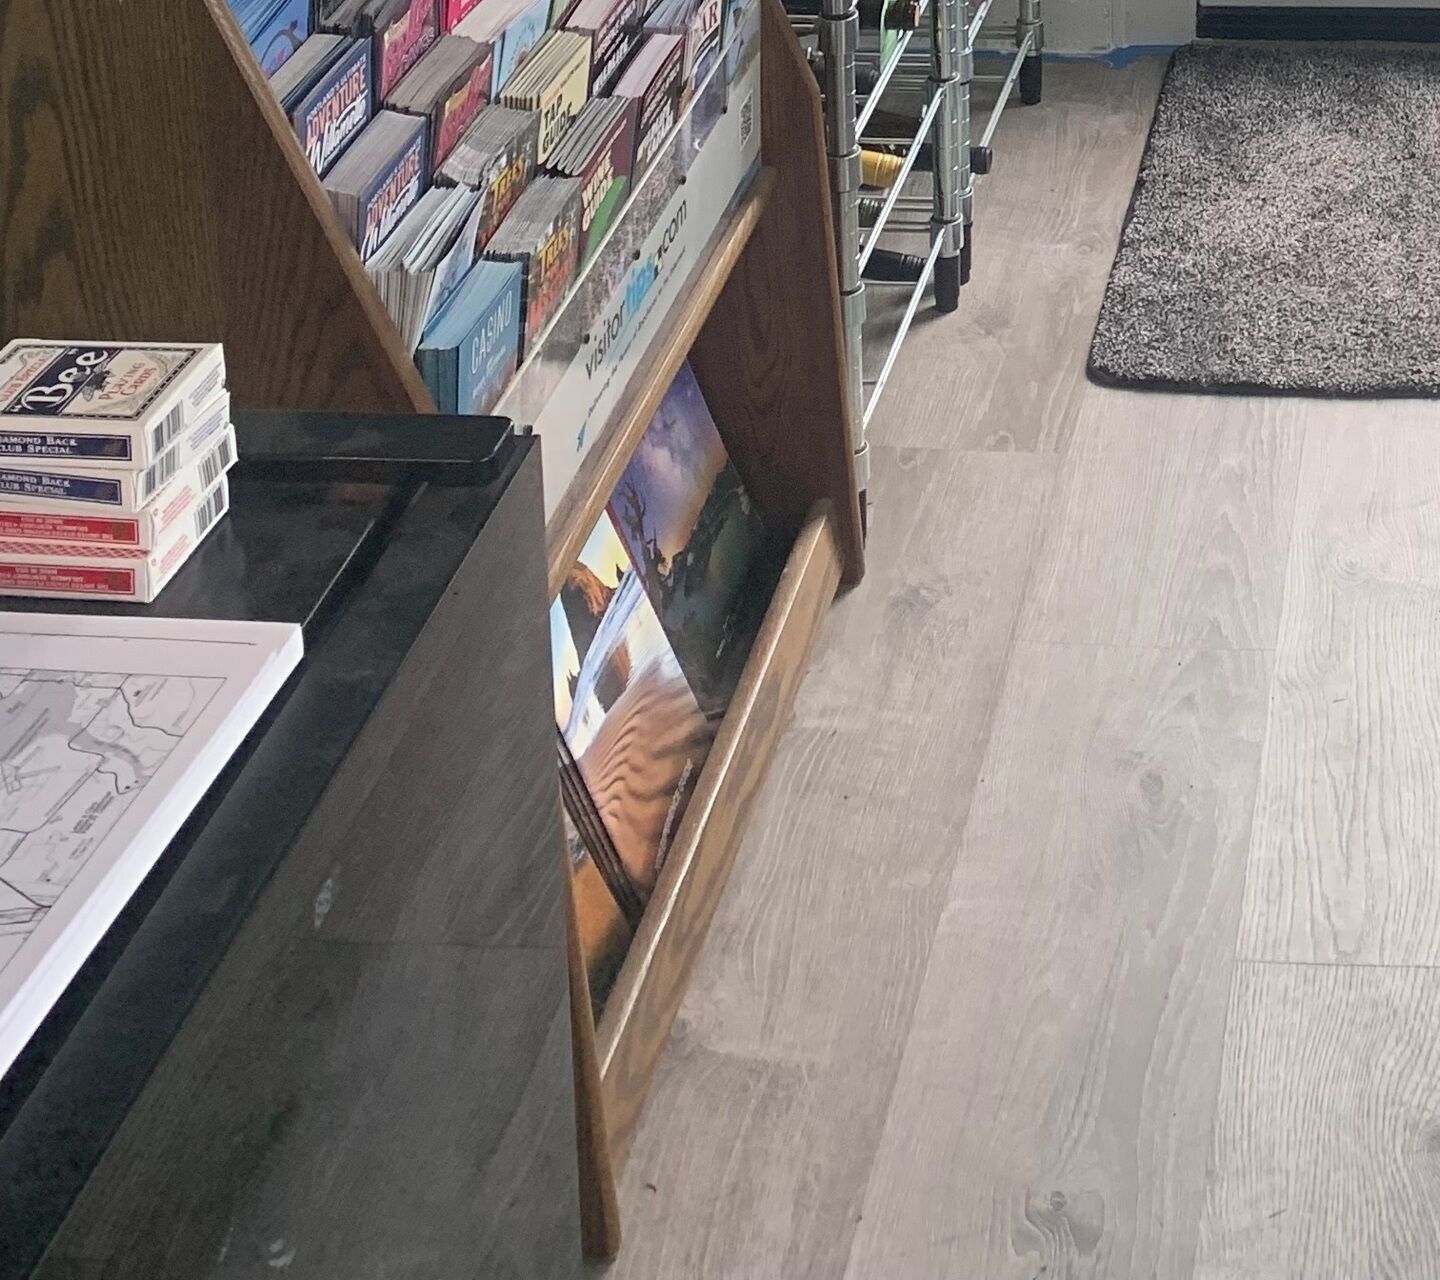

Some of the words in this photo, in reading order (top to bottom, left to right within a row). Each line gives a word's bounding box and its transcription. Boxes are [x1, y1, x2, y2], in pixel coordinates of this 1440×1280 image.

[306, 63, 366, 146] ADVENTURE
[544, 93, 563, 126] TAP
[542, 101, 573, 154] GUIDE
[581, 148, 612, 206] WINE
[581, 166, 614, 233] GUIDE
[470, 290, 514, 375] CASINO
[98, 361, 145, 400] PLAYING
[120, 366, 157, 396] CARDS
[0, 436, 41, 445] AMOND
[46, 435, 78, 446] BACK
[27, 444, 72, 454] SPECIAL
[42, 476, 71, 487] BACK
